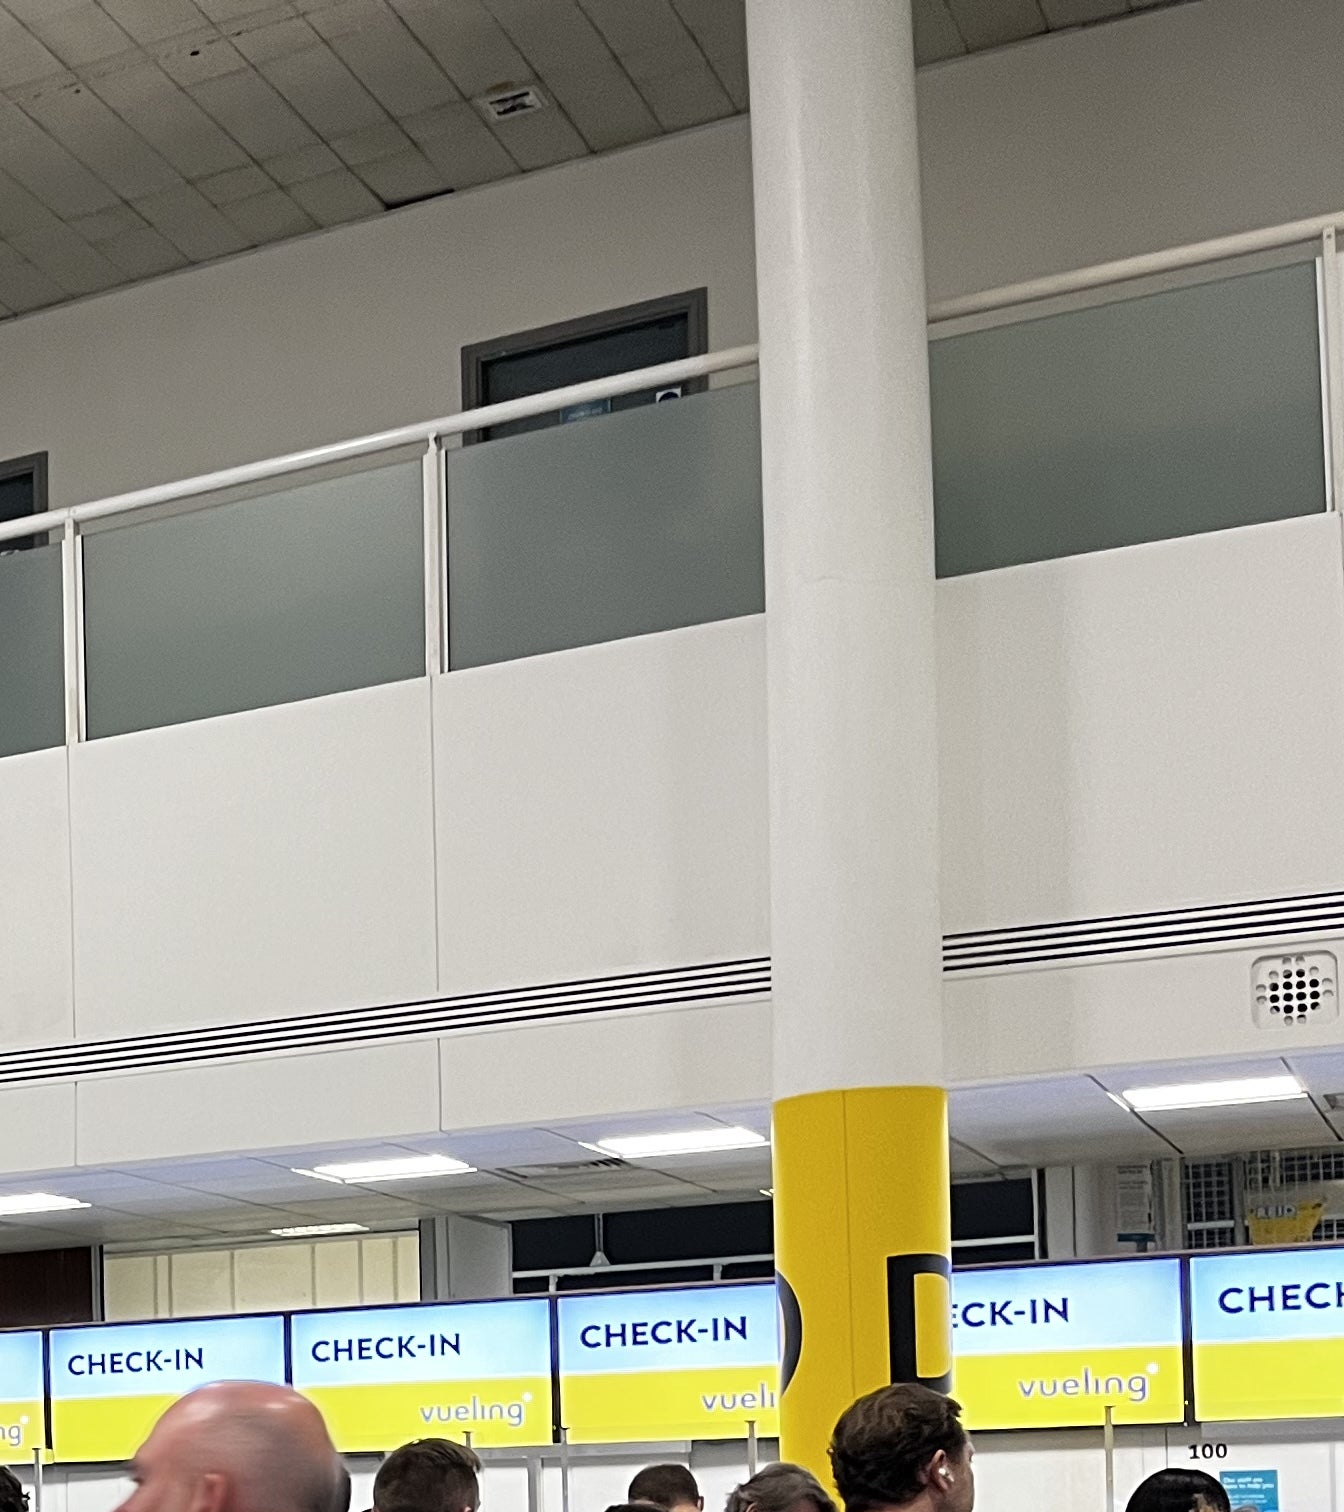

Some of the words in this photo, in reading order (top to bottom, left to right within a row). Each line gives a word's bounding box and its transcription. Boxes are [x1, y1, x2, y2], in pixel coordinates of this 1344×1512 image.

[580, 1316, 747, 1348] CHECK-IN
[68, 1348, 204, 1376] CHECK-IN
[311, 1333, 460, 1362] CHECK-IN
[1018, 1369, 1146, 1402] vueling
[420, 1396, 523, 1426] vueling
[1188, 1443, 1227, 1459] 100
